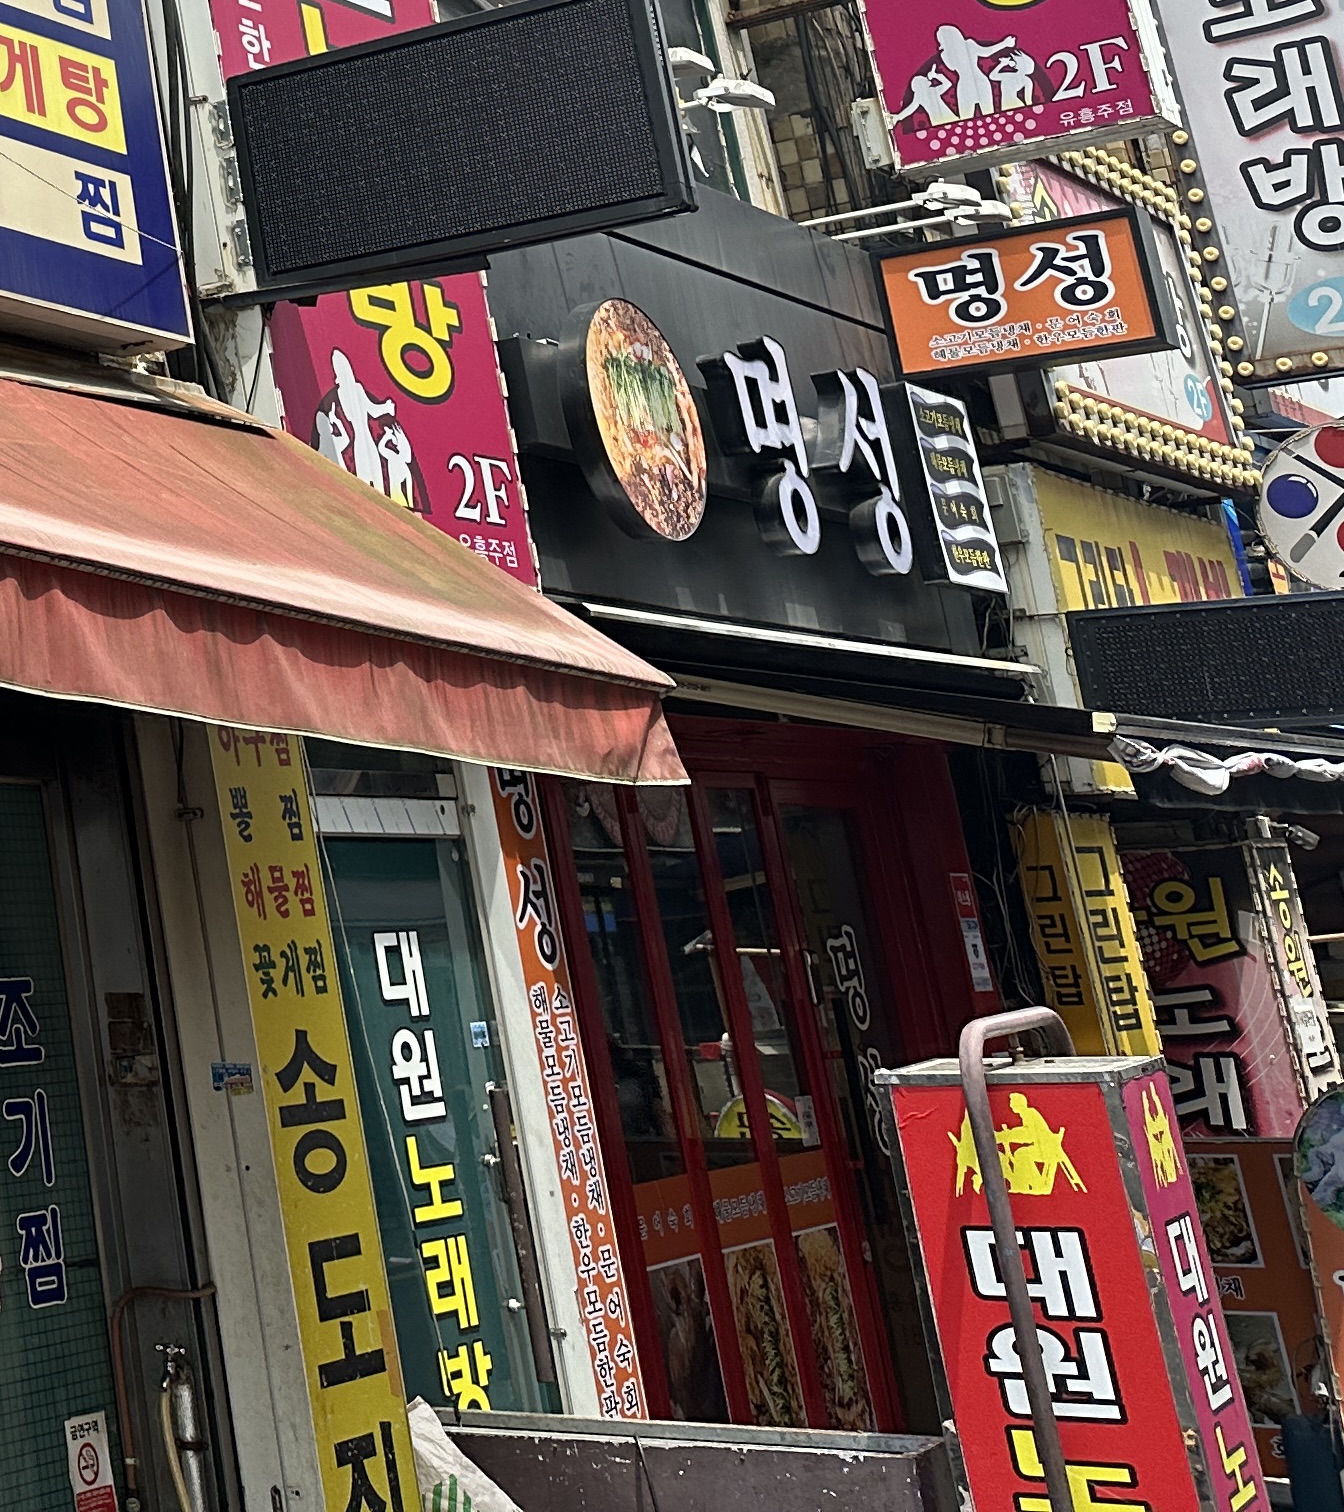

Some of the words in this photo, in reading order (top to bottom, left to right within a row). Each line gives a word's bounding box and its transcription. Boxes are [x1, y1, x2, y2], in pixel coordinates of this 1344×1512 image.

[1045, 35, 1130, 103] 2F
[1058, 99, 1135, 129] 유흥주점
[908, 230, 1116, 327] 명성
[448, 453, 512, 525] 2F
[723, 335, 913, 575] 명성
[241, 862, 317, 920] 해물찜
[253, 938, 328, 999] 꽃게찜
[1076, 845, 1143, 1031] 그린탑
[69, 1419, 100, 1441] 금연구역
